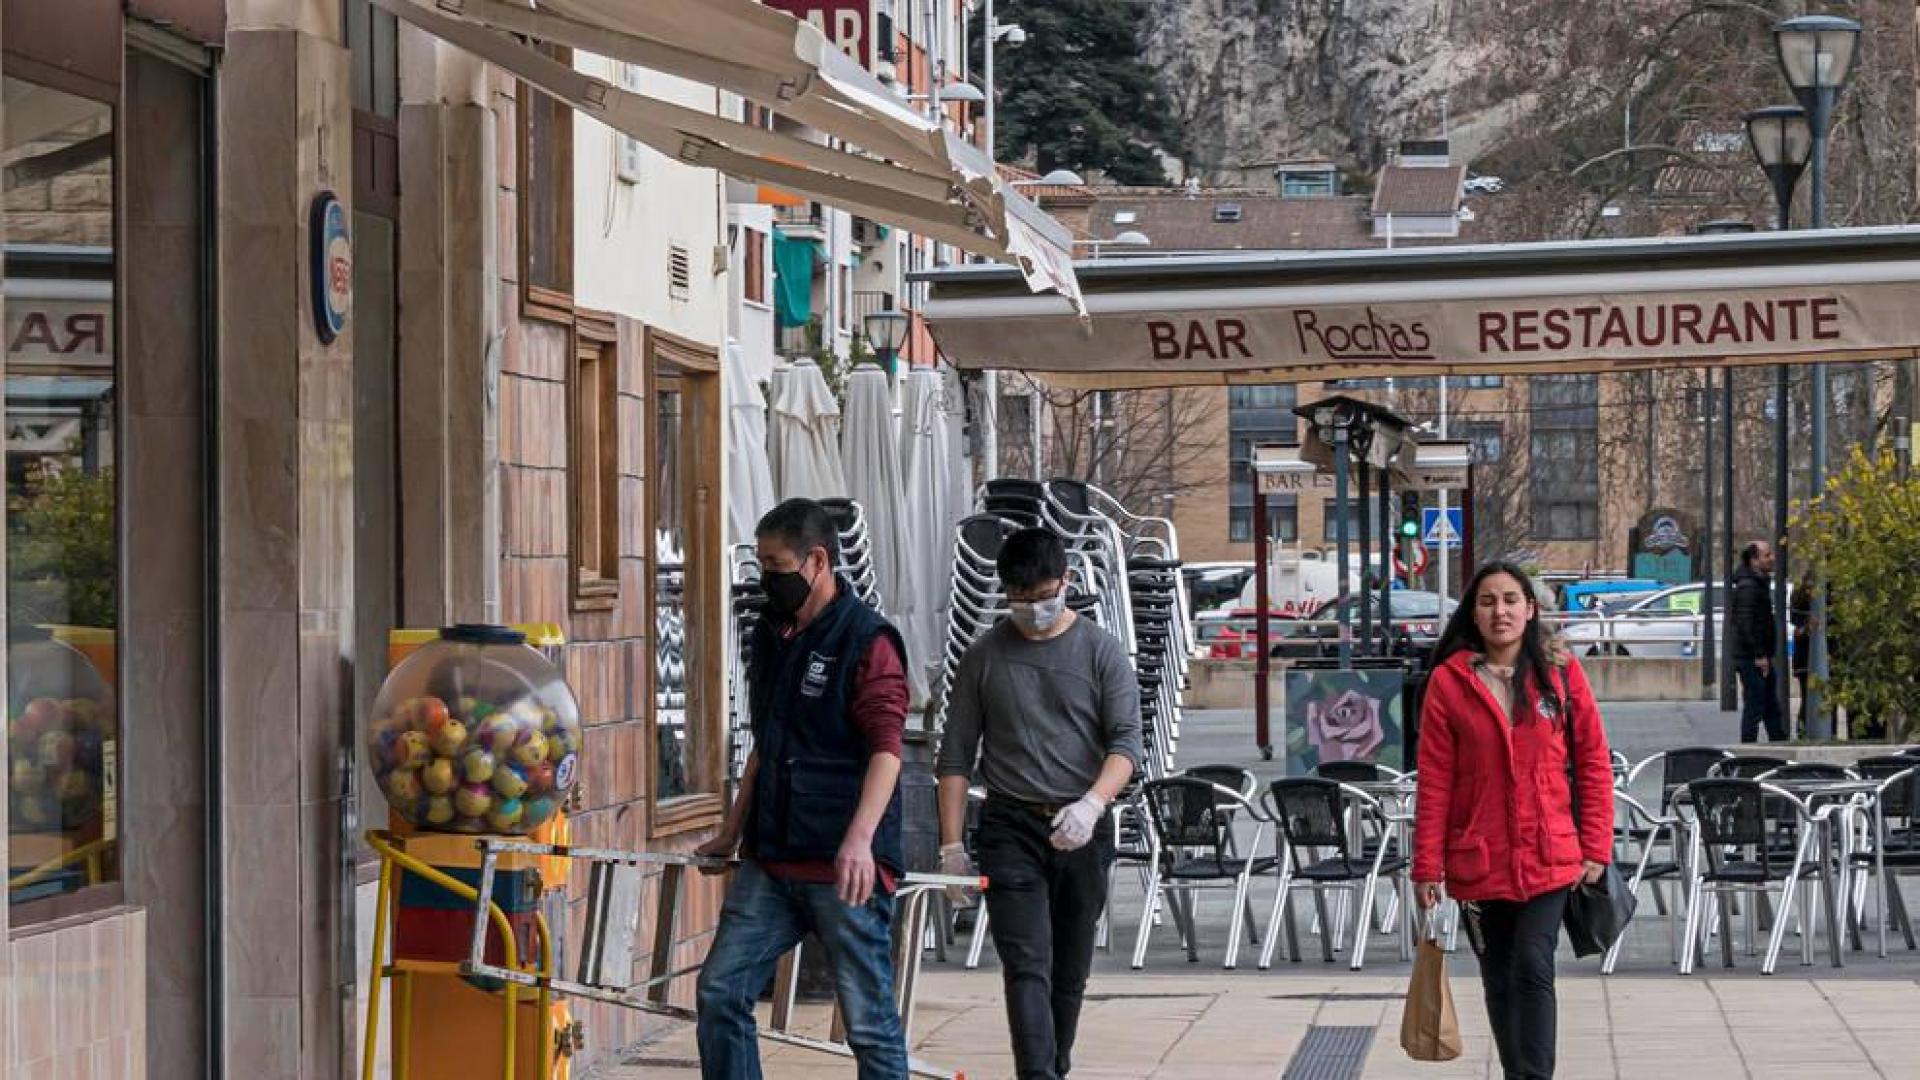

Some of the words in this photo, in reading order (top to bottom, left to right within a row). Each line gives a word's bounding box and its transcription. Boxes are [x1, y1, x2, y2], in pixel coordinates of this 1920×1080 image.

[1148, 319, 1253, 359] BAR
[1293, 306, 1435, 359] Rochas
[1478, 298, 1840, 352] RESTAURANTE
[1264, 473, 1304, 489] BAR
